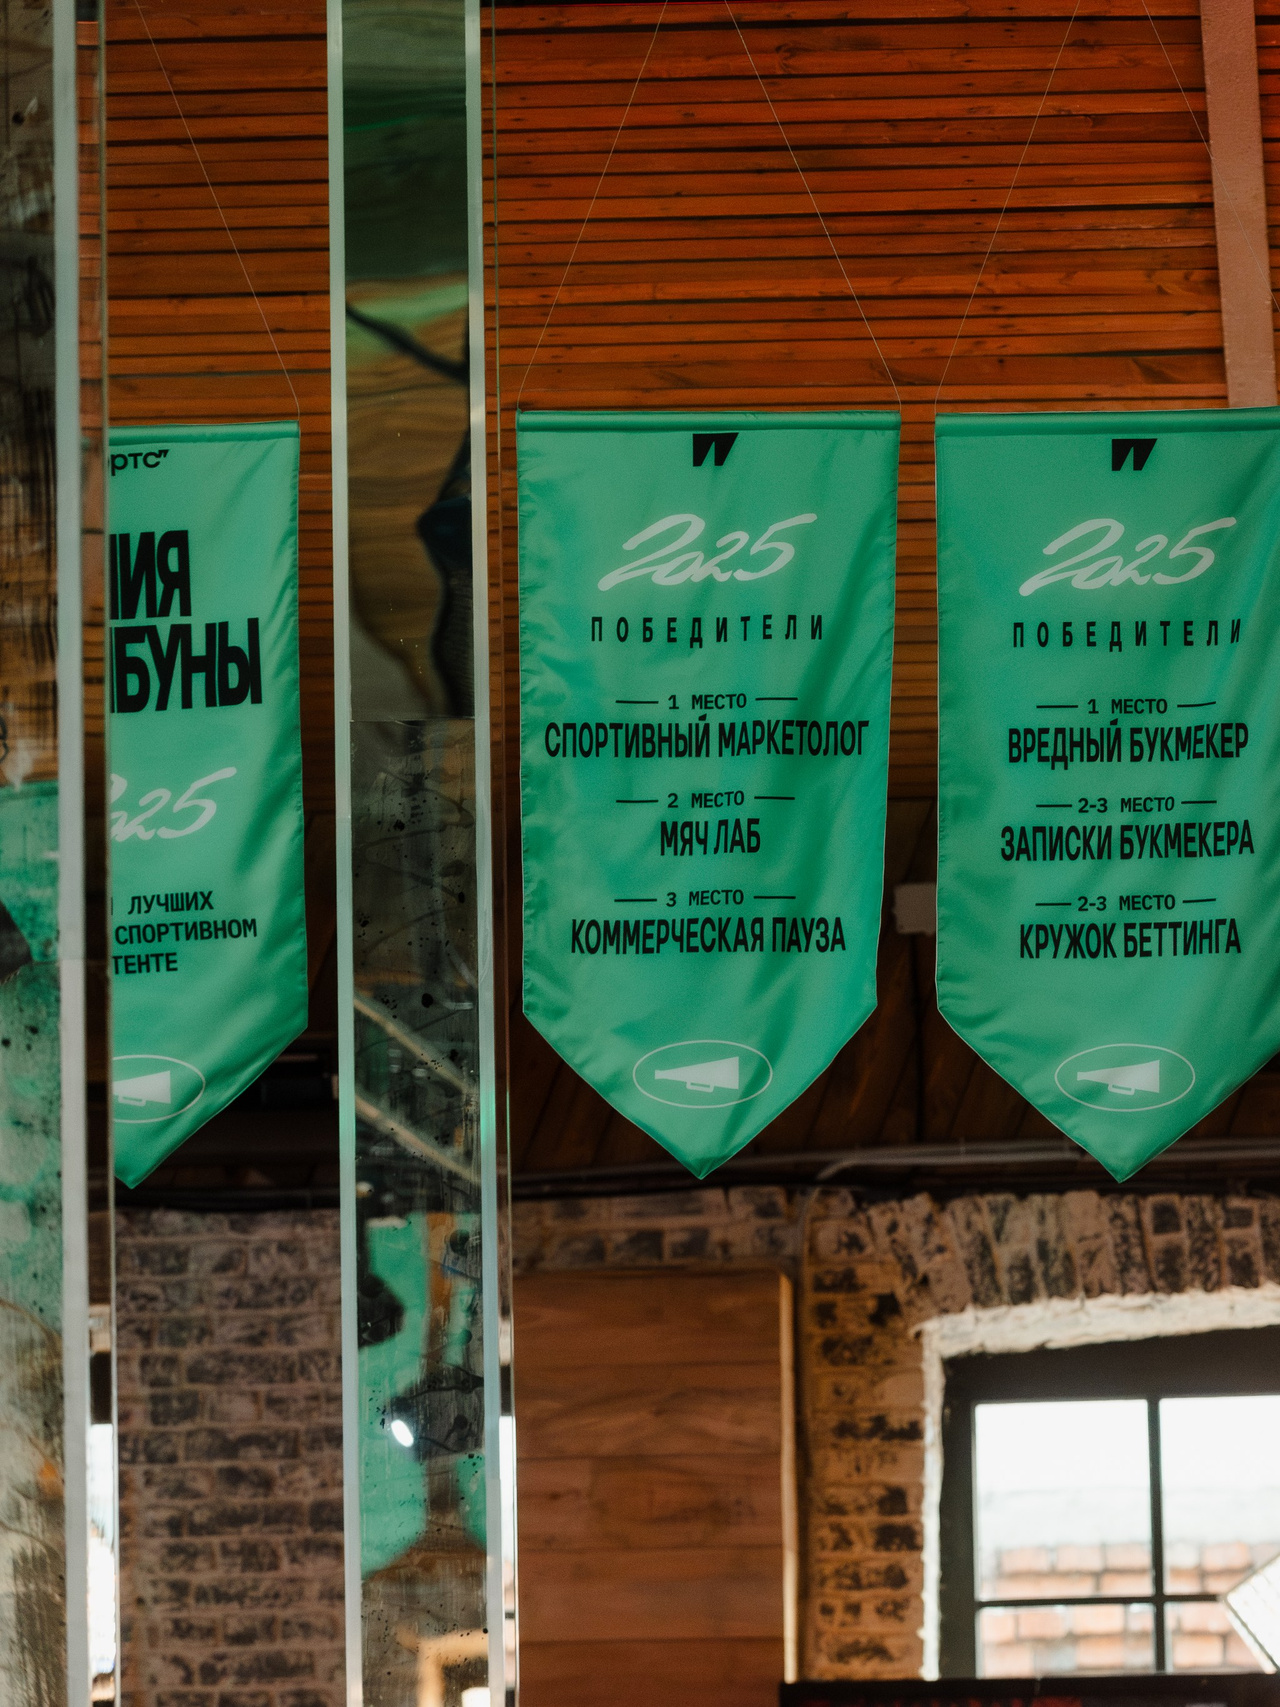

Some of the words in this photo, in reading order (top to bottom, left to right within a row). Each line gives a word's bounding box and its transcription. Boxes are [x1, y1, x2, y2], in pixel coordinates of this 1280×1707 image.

[597, 513, 818, 591] 2025
[1018, 517, 1237, 597] 2025
[590, 614, 823, 648] ПОБЕДИТЕЛИ
[1012, 618, 1243, 652] ПОБЕДИТЕЛИ
[110, 617, 262, 714] БУНЫ
[667, 694, 680, 710] 1
[690, 693, 748, 710] МЕСТО
[1087, 699, 1100, 714] 1
[1110, 698, 1168, 715] МЕСТО
[544, 713, 711, 759] СПОРТИВНЫЙ
[718, 719, 870, 757] МАРКЕТОЛОГ
[1008, 719, 1123, 770] ВРЕДНЫЙ
[1129, 722, 1249, 763] БУКМЕКЕР
[667, 793, 680, 809] 2
[690, 790, 746, 809] МЕСТО
[1077, 798, 1108, 814] 2-3
[1121, 796, 1176, 814] МЕСТО
[659, 819, 710, 857] МЯЧ
[714, 817, 761, 855] ЛАБ
[1000, 824, 1113, 862] ЗАПИСКИ
[1119, 819, 1255, 860] БУКМЕКЕРА
[127, 890, 214, 915] ЛУЧШИХ
[665, 891, 678, 908] 3
[688, 889, 745, 907] МЕСТО
[1077, 896, 1108, 912] 2-3
[1119, 895, 1176, 911] МЕСТО
[114, 918, 257, 945] СПОРТИВНОМ
[570, 918, 764, 955] КОММЕРЧЕСКАЯ
[771, 917, 847, 952] ПАУЗА
[1019, 922, 1117, 960] КРУЖОК
[1123, 918, 1242, 958] БЕТТИНГА
